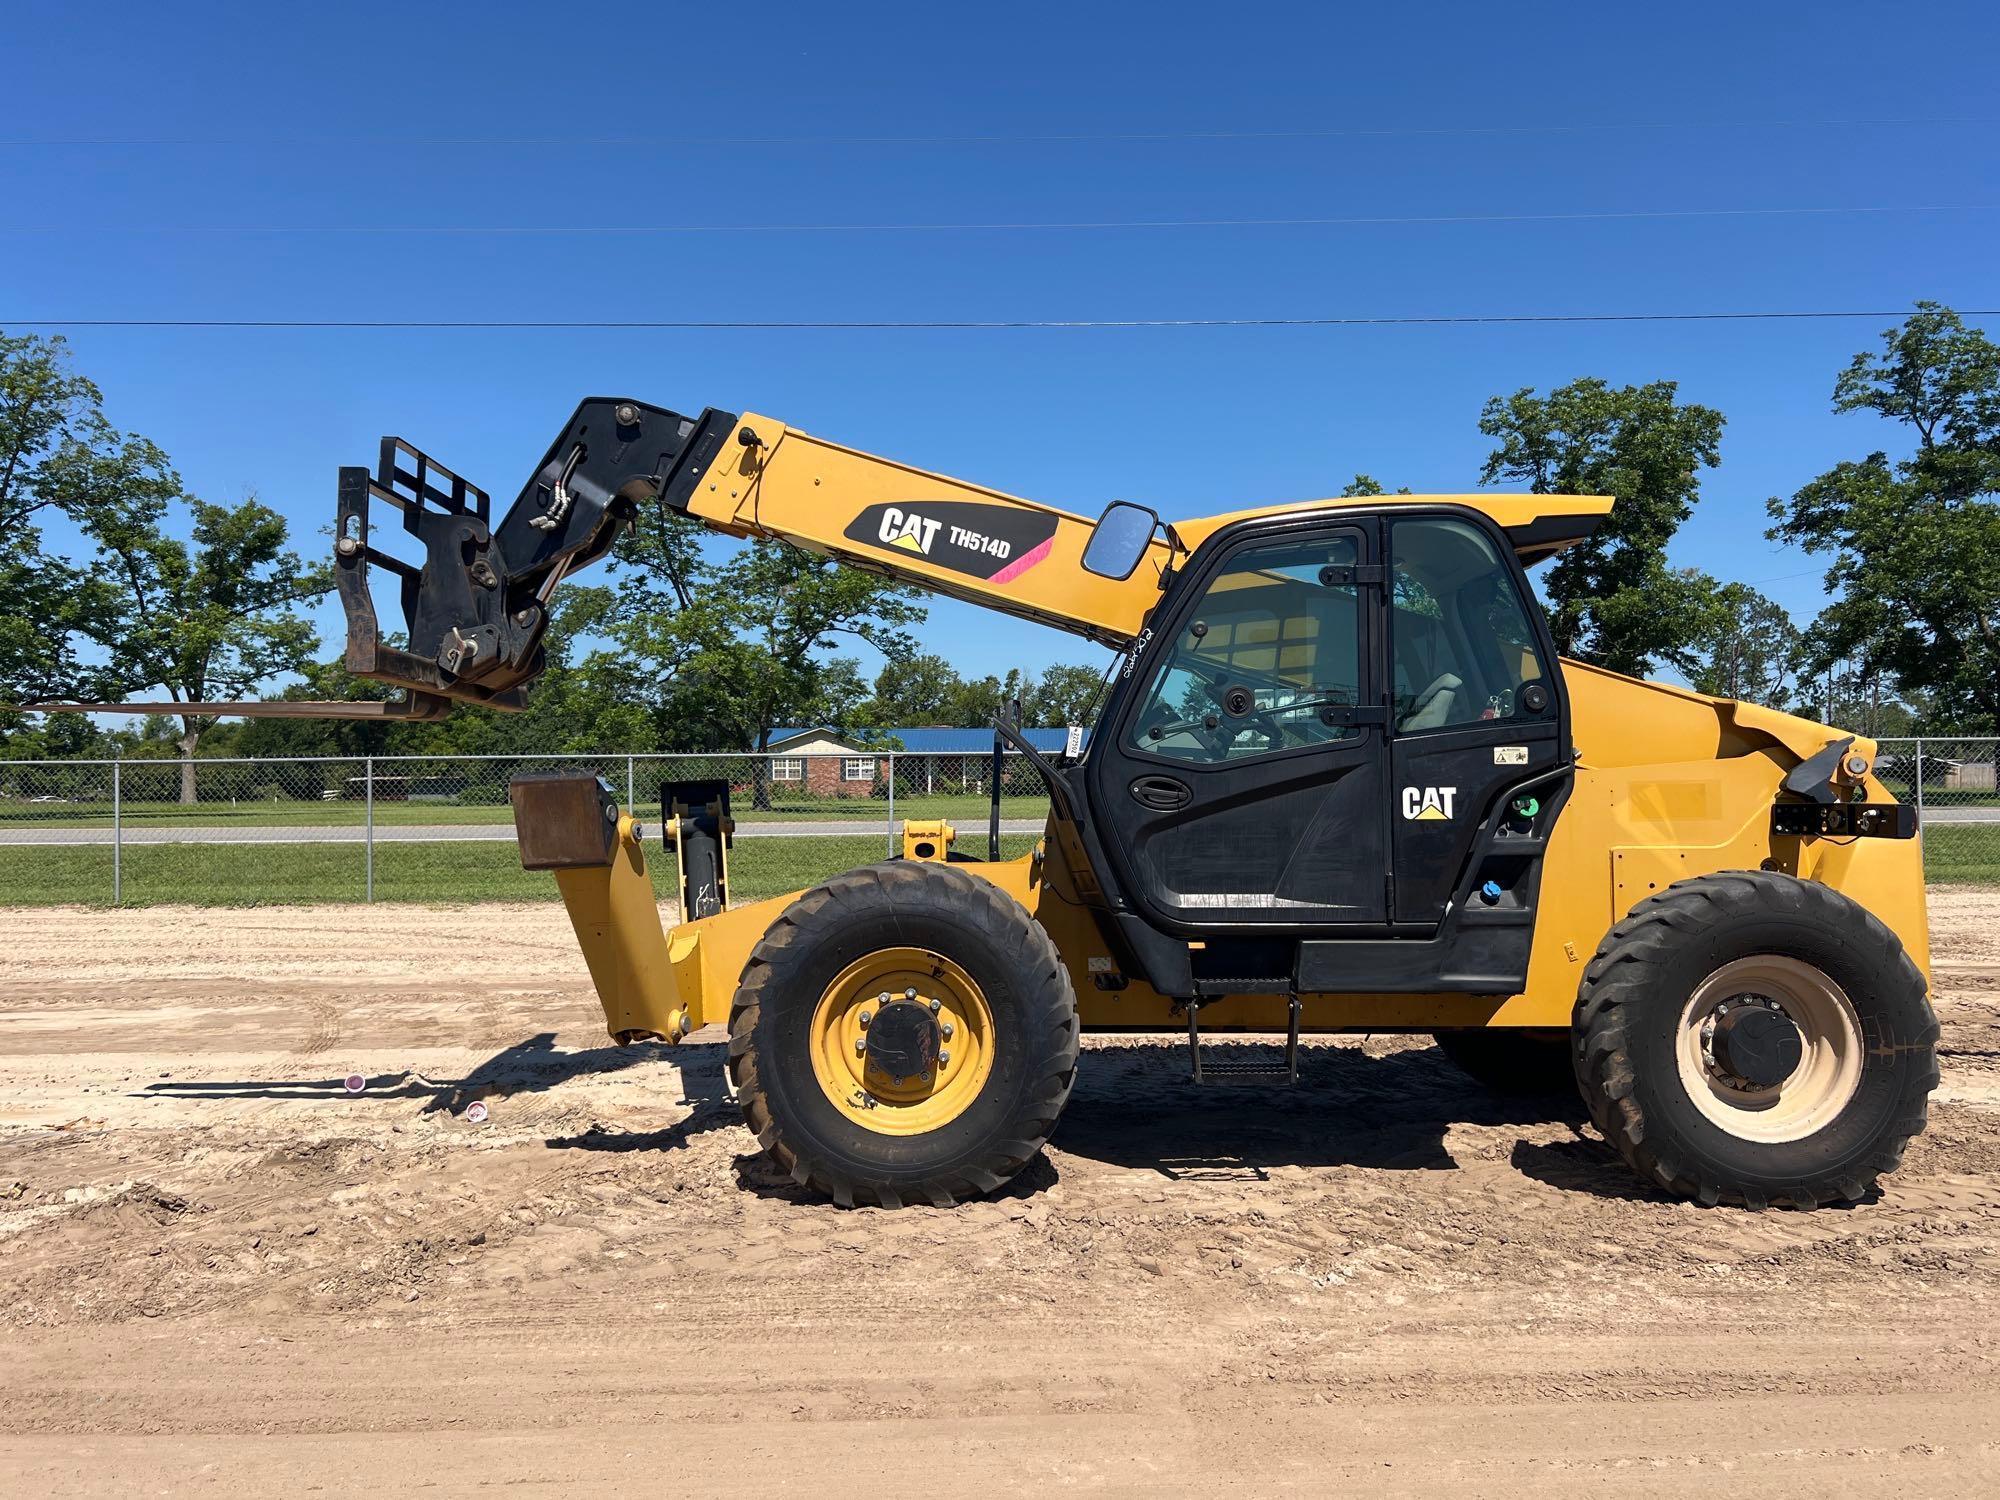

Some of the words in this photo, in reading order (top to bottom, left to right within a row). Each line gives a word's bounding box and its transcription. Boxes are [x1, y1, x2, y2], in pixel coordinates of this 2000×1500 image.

[878, 507, 943, 555] CAT
[949, 525, 1011, 559] TH514D
[1071, 732, 1080, 754] 222502
[1402, 786, 1457, 820] CAT
